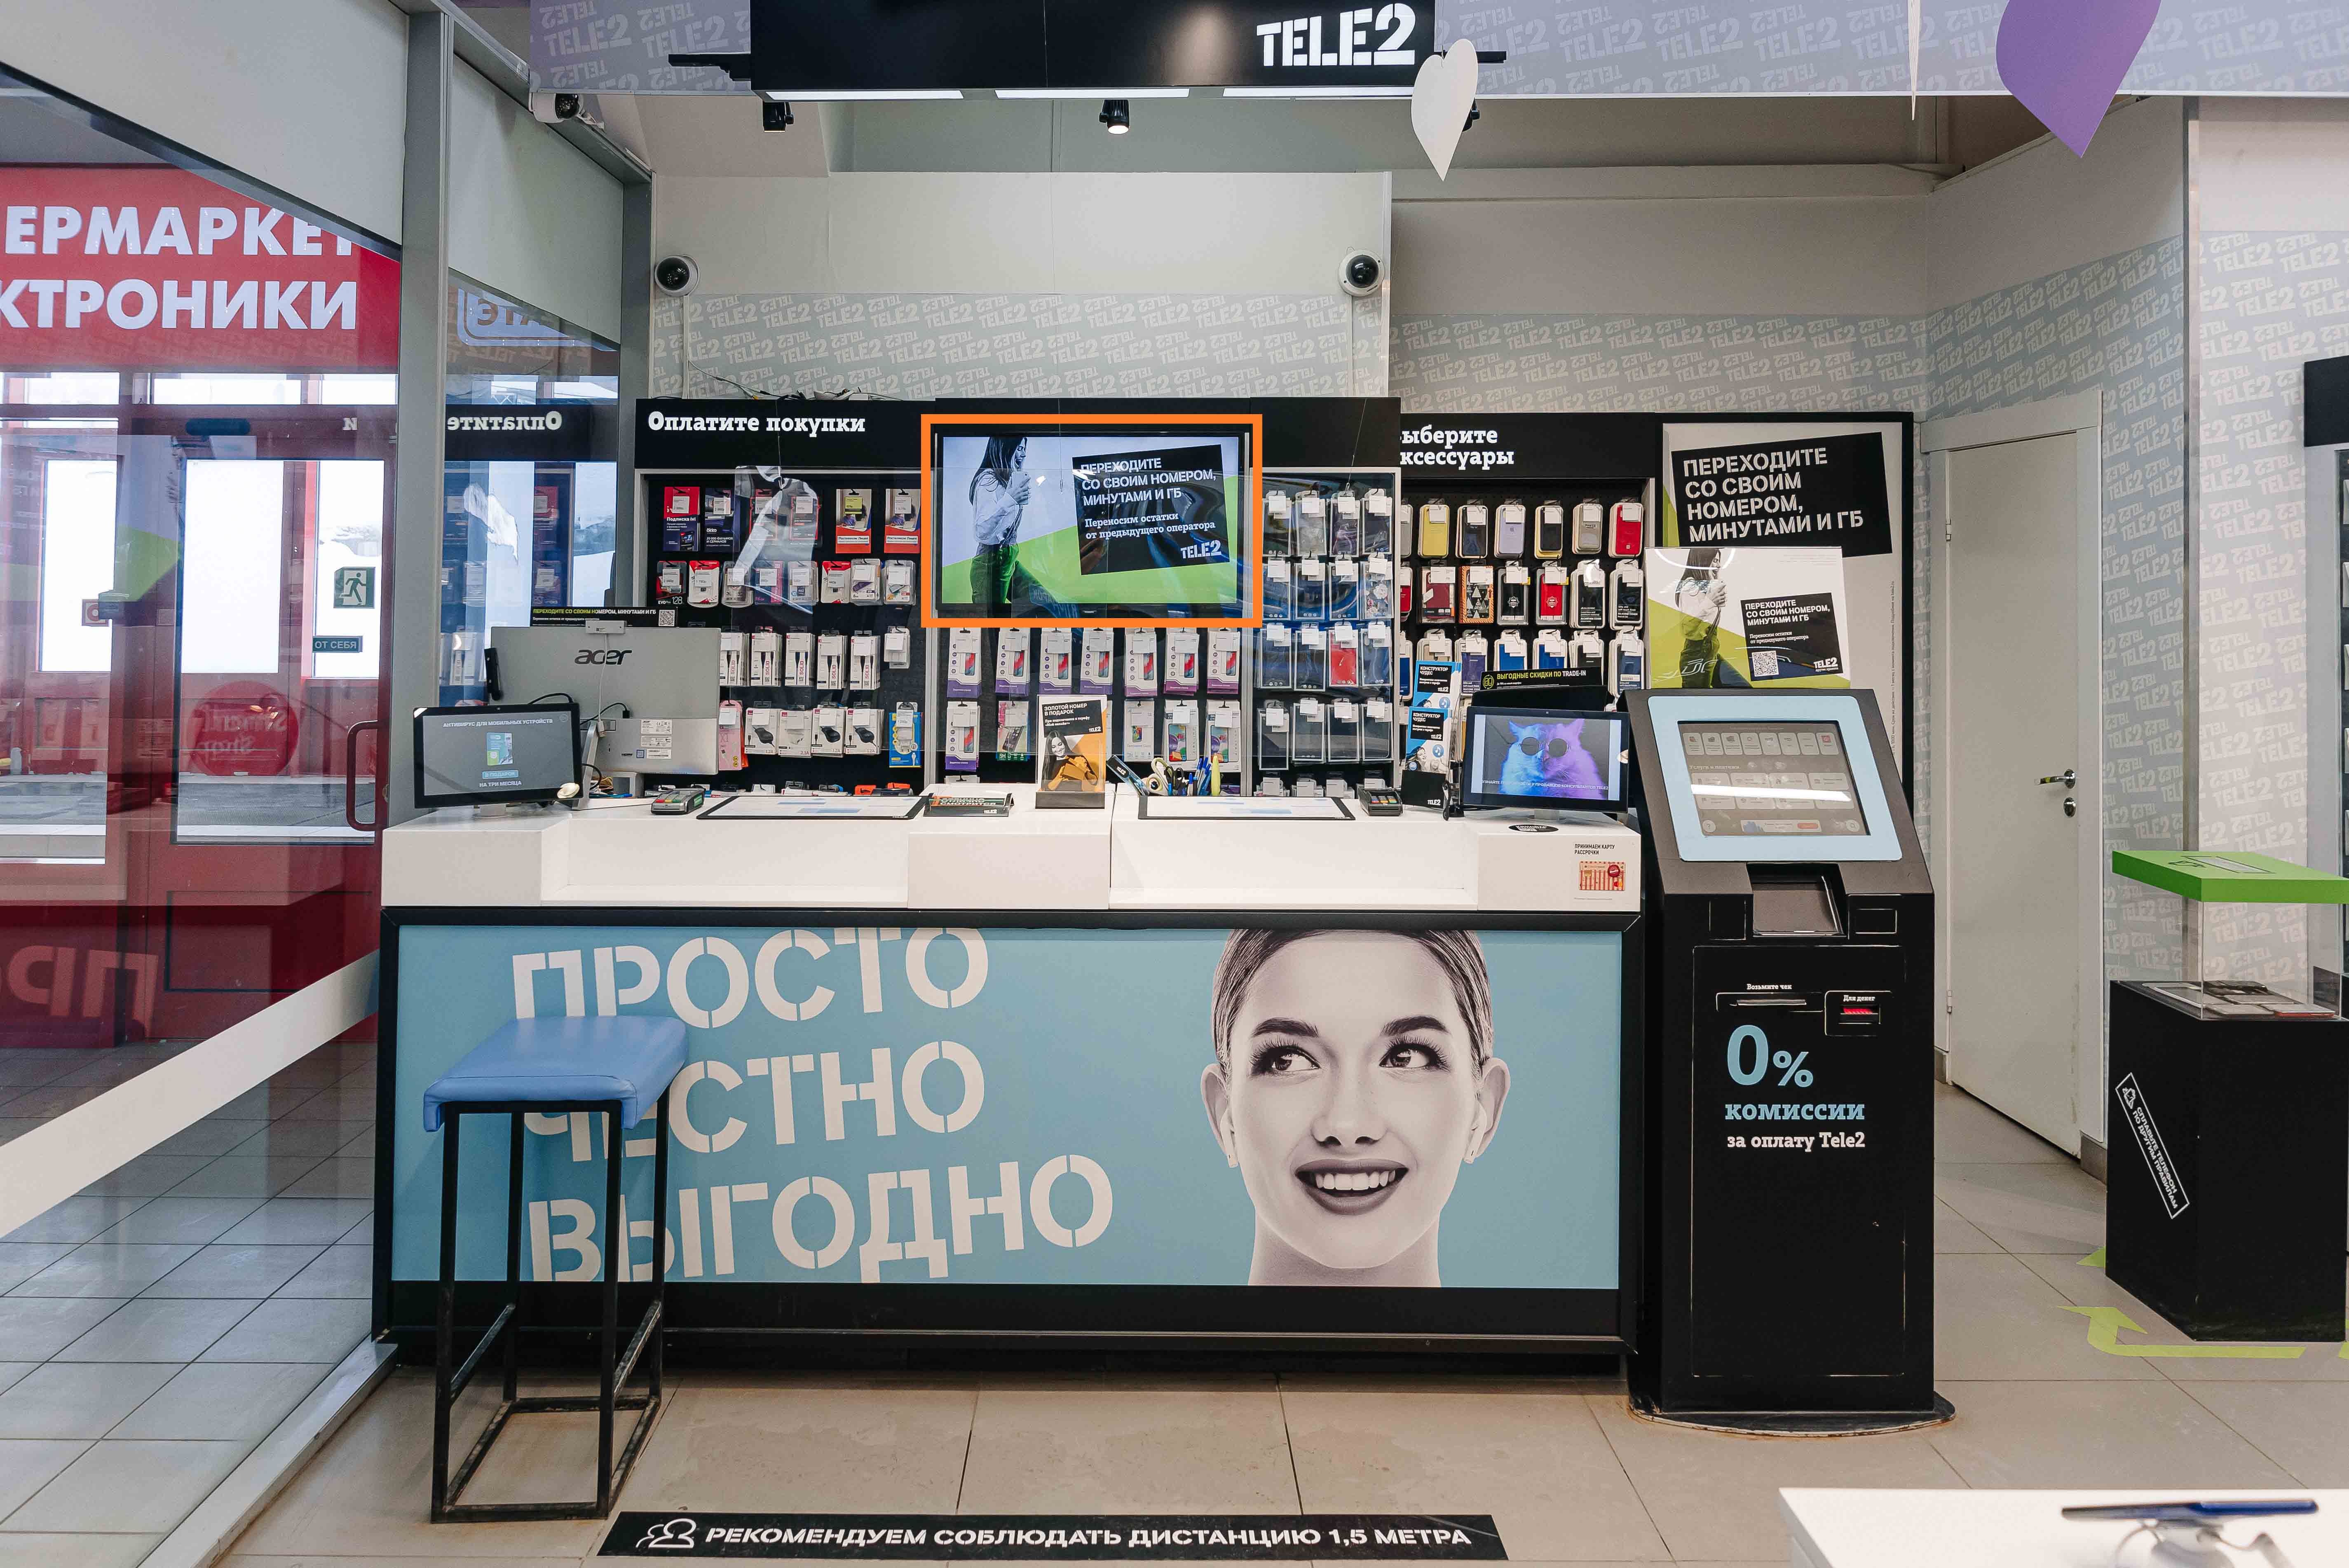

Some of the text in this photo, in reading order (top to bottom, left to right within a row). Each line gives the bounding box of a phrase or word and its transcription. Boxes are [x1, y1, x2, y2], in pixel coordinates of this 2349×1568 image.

[544, 14, 632, 56] TELE2
[1257, 4, 1416, 66] TELE2
[1655, 17, 1743, 61] TELE2
[1754, 17, 1842, 61] TELE2
[2197, 18, 2284, 61] TELE2
[2214, 243, 2273, 273] TELE2
[2281, 244, 2340, 273] TELE2
[708, 304, 759, 328] TELE2
[816, 304, 866, 328] TELE2
[977, 304, 1027, 328] TELE2
[1406, 327, 1448, 352] TELE2
[2258, 331, 2318, 361] TELE2
[648, 412, 865, 437] Оплатите покупки
[2237, 420, 2296, 450] TELE2
[1400, 425, 1498, 449] ыберите
[1081, 457, 1161, 473] ПЕРЕХОДИТЕ
[1400, 450, 1514, 470] ксессуары
[1683, 448, 1828, 477] ПЕРЕХОДИТЕ
[1082, 469, 1216, 490] СО СВОИМ НОМЕРОМ,
[1685, 472, 1801, 498] СО СВОИМ
[1083, 488, 1182, 506] МИНУТАМИ И ГБ
[1688, 495, 1803, 520] НОМЕРОМ,
[1085, 513, 1179, 529] Переносим остатки
[1099, 526, 1164, 540] предыдущего
[1166, 522, 1216, 534] оператора
[1689, 510, 1863, 542] МИНУТАМИ И ГБ
[1180, 540, 1222, 558] TELE2
[1745, 600, 1796, 610] ПЕРЕХОДИТЕ
[1759, 608, 1788, 617] СВОИМ
[1789, 605, 1830, 614] НОМЕРОМ,
[1747, 616, 1791, 626] МИНУТАМИ
[330, 641, 357, 649] СЕБЯ
[574, 649, 632, 665] acer
[1813, 657, 1838, 668] TELE2
[1116, 766, 1126, 776] TELE2
[512, 928, 988, 1029] ПРОСТО
[1727, 1024, 1813, 1087] 0%
[1725, 1104, 1865, 1120] комиссии
[1728, 1132, 1866, 1153] за оплату Tele2
[2137, 1107, 2178, 1194] СПЛАВЬТЕ ТЕЛЕФОН
[2133, 1111, 2178, 1209] ПО ДРУГИМ ПРАВИЛАМ
[529, 1154, 1113, 1283] ВЫГОДНО
[705, 1528, 1472, 1548] РЕКОМЕНДУЕМ СОБЛЮДАТЬ ДИСТАНЦИЮ 1,5 МЕТРА
